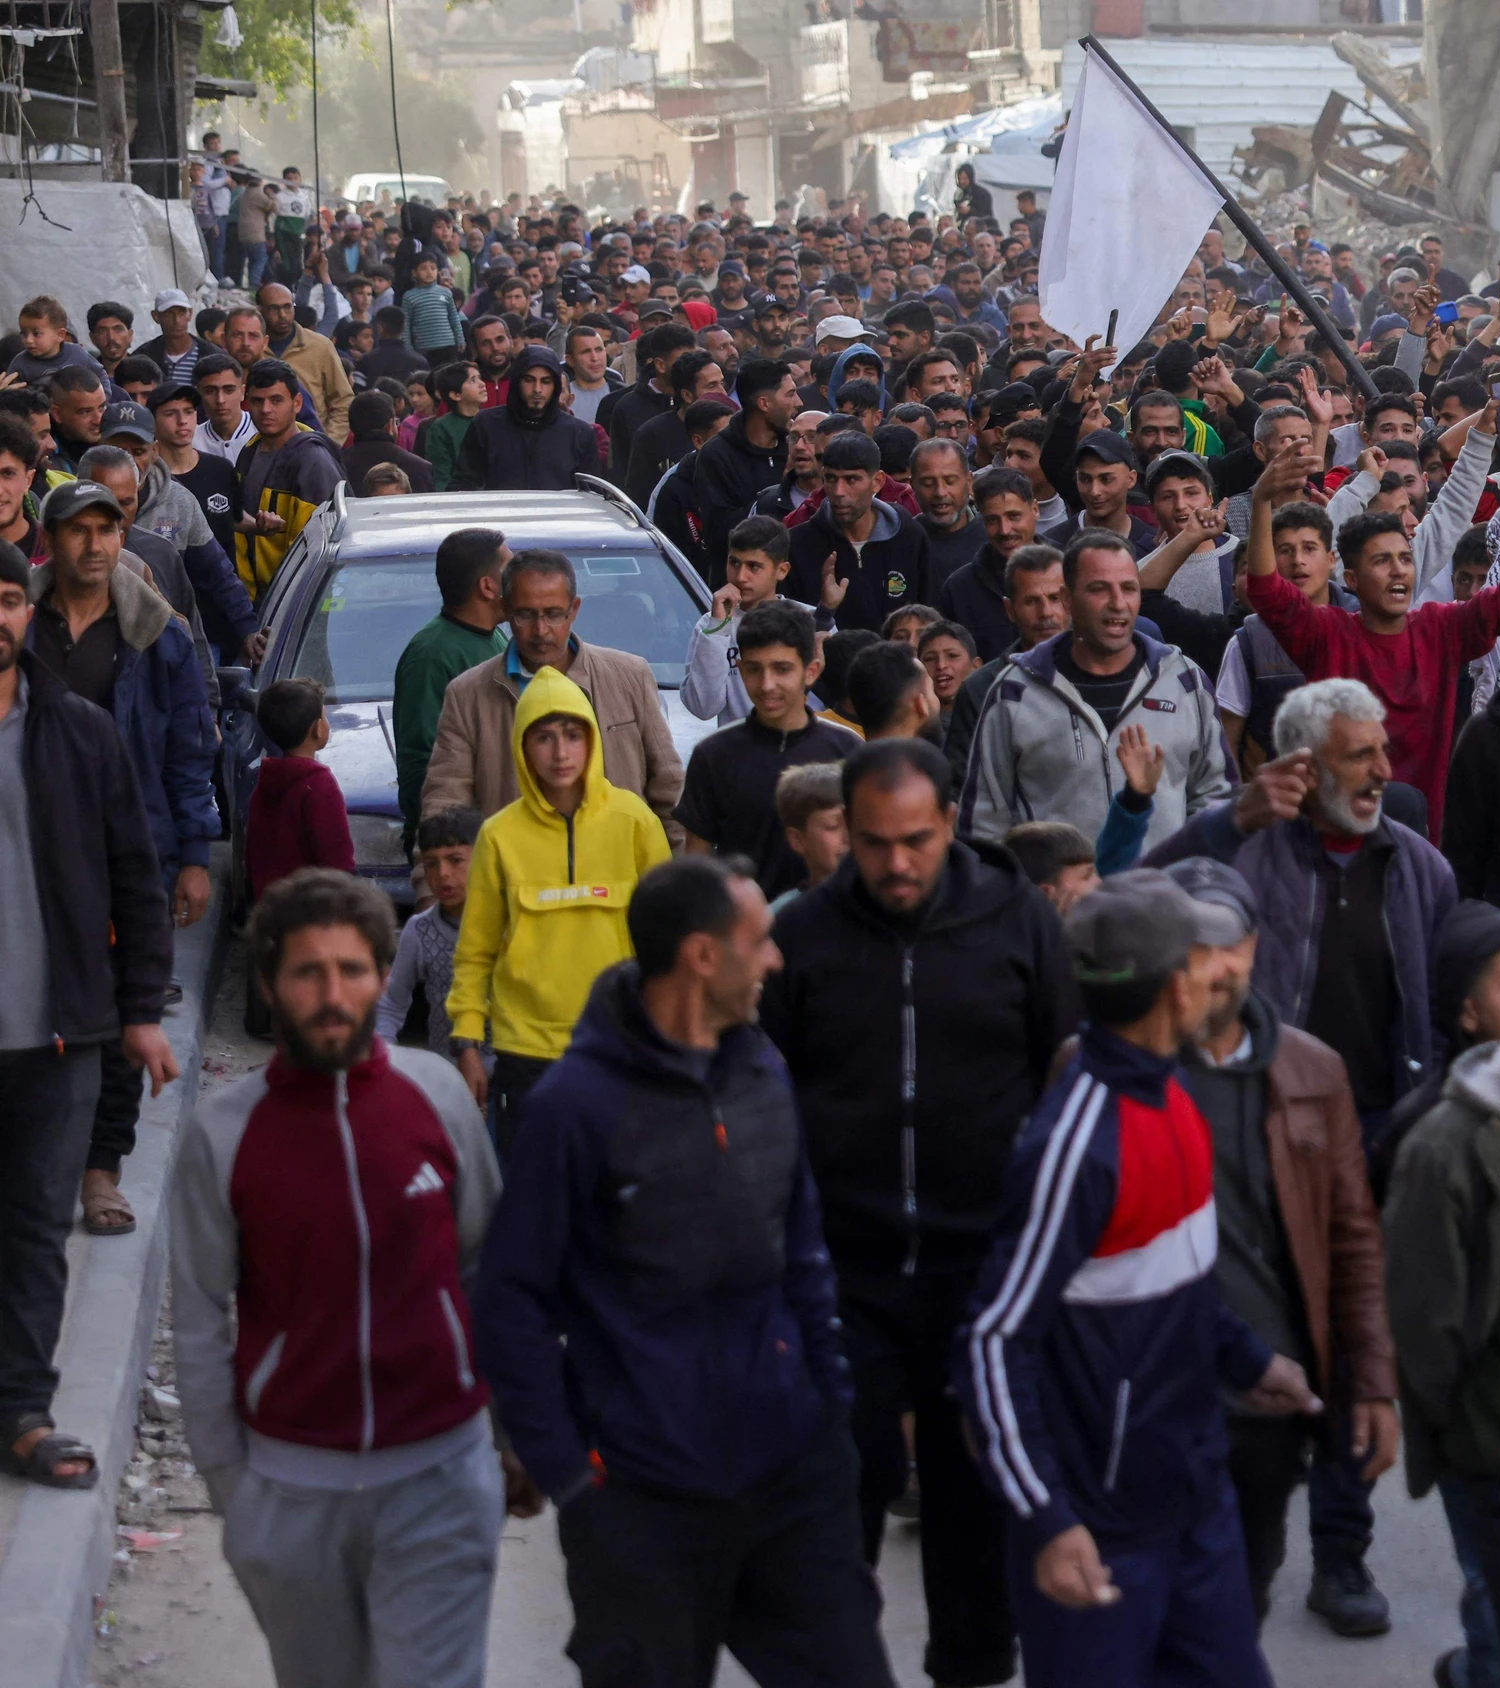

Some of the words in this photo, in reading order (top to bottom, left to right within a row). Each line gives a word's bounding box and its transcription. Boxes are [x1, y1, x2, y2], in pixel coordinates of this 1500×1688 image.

[765, 293, 777, 303] NY
[119, 406, 136, 421] NY
[1159, 700, 1175, 711] TIM
